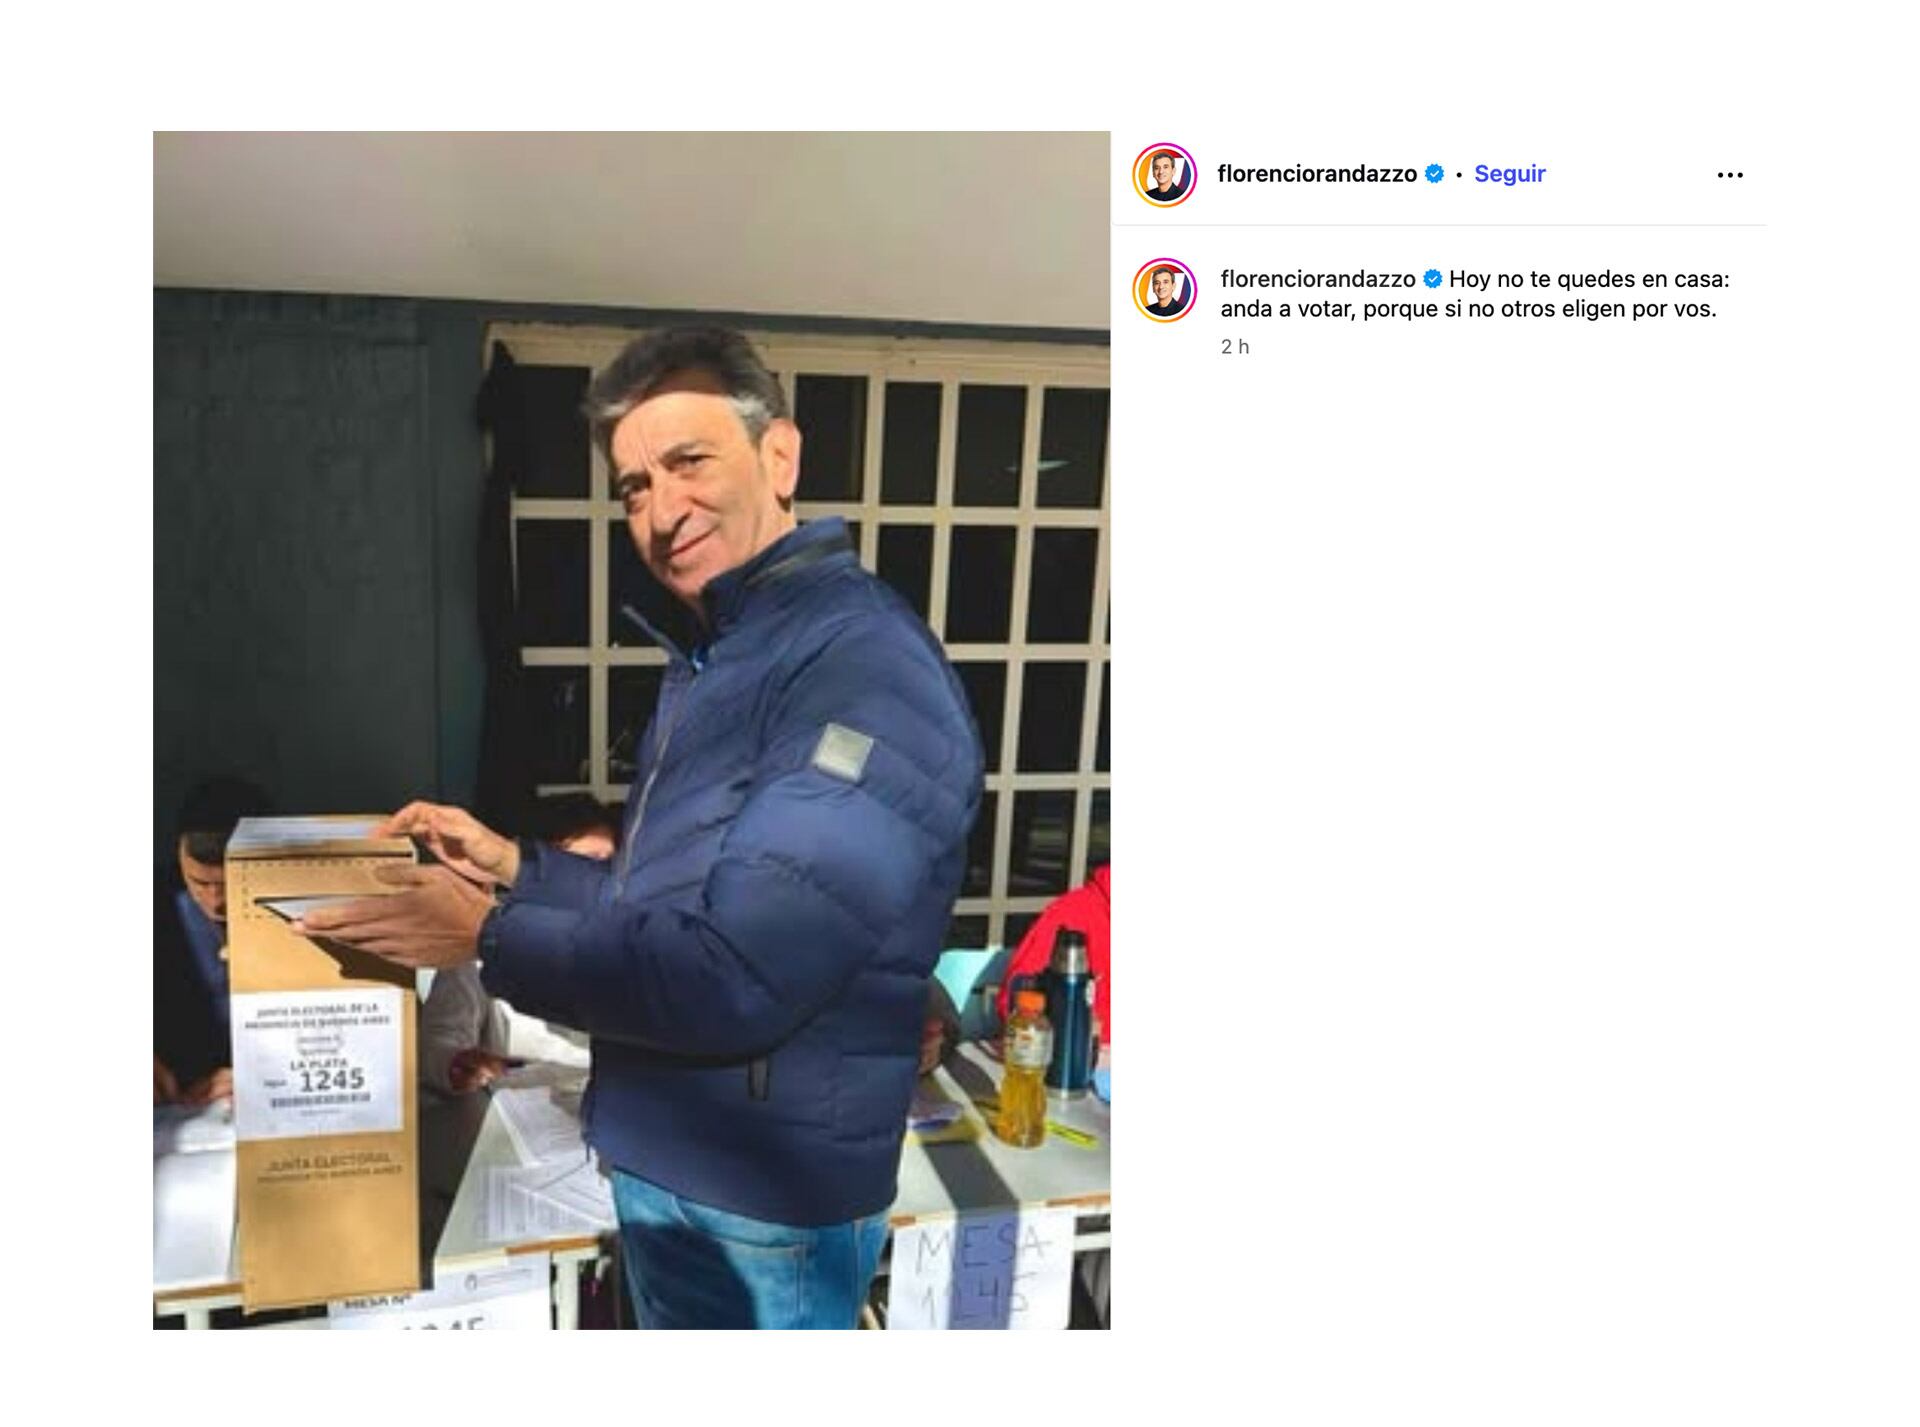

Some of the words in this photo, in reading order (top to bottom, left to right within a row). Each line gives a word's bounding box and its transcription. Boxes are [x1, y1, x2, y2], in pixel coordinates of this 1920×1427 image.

[290, 1060, 305, 1071] LA
[309, 1058, 348, 1069] PLATA
[300, 1068, 365, 1092] 1245
[916, 1222, 1053, 1274] MESA
